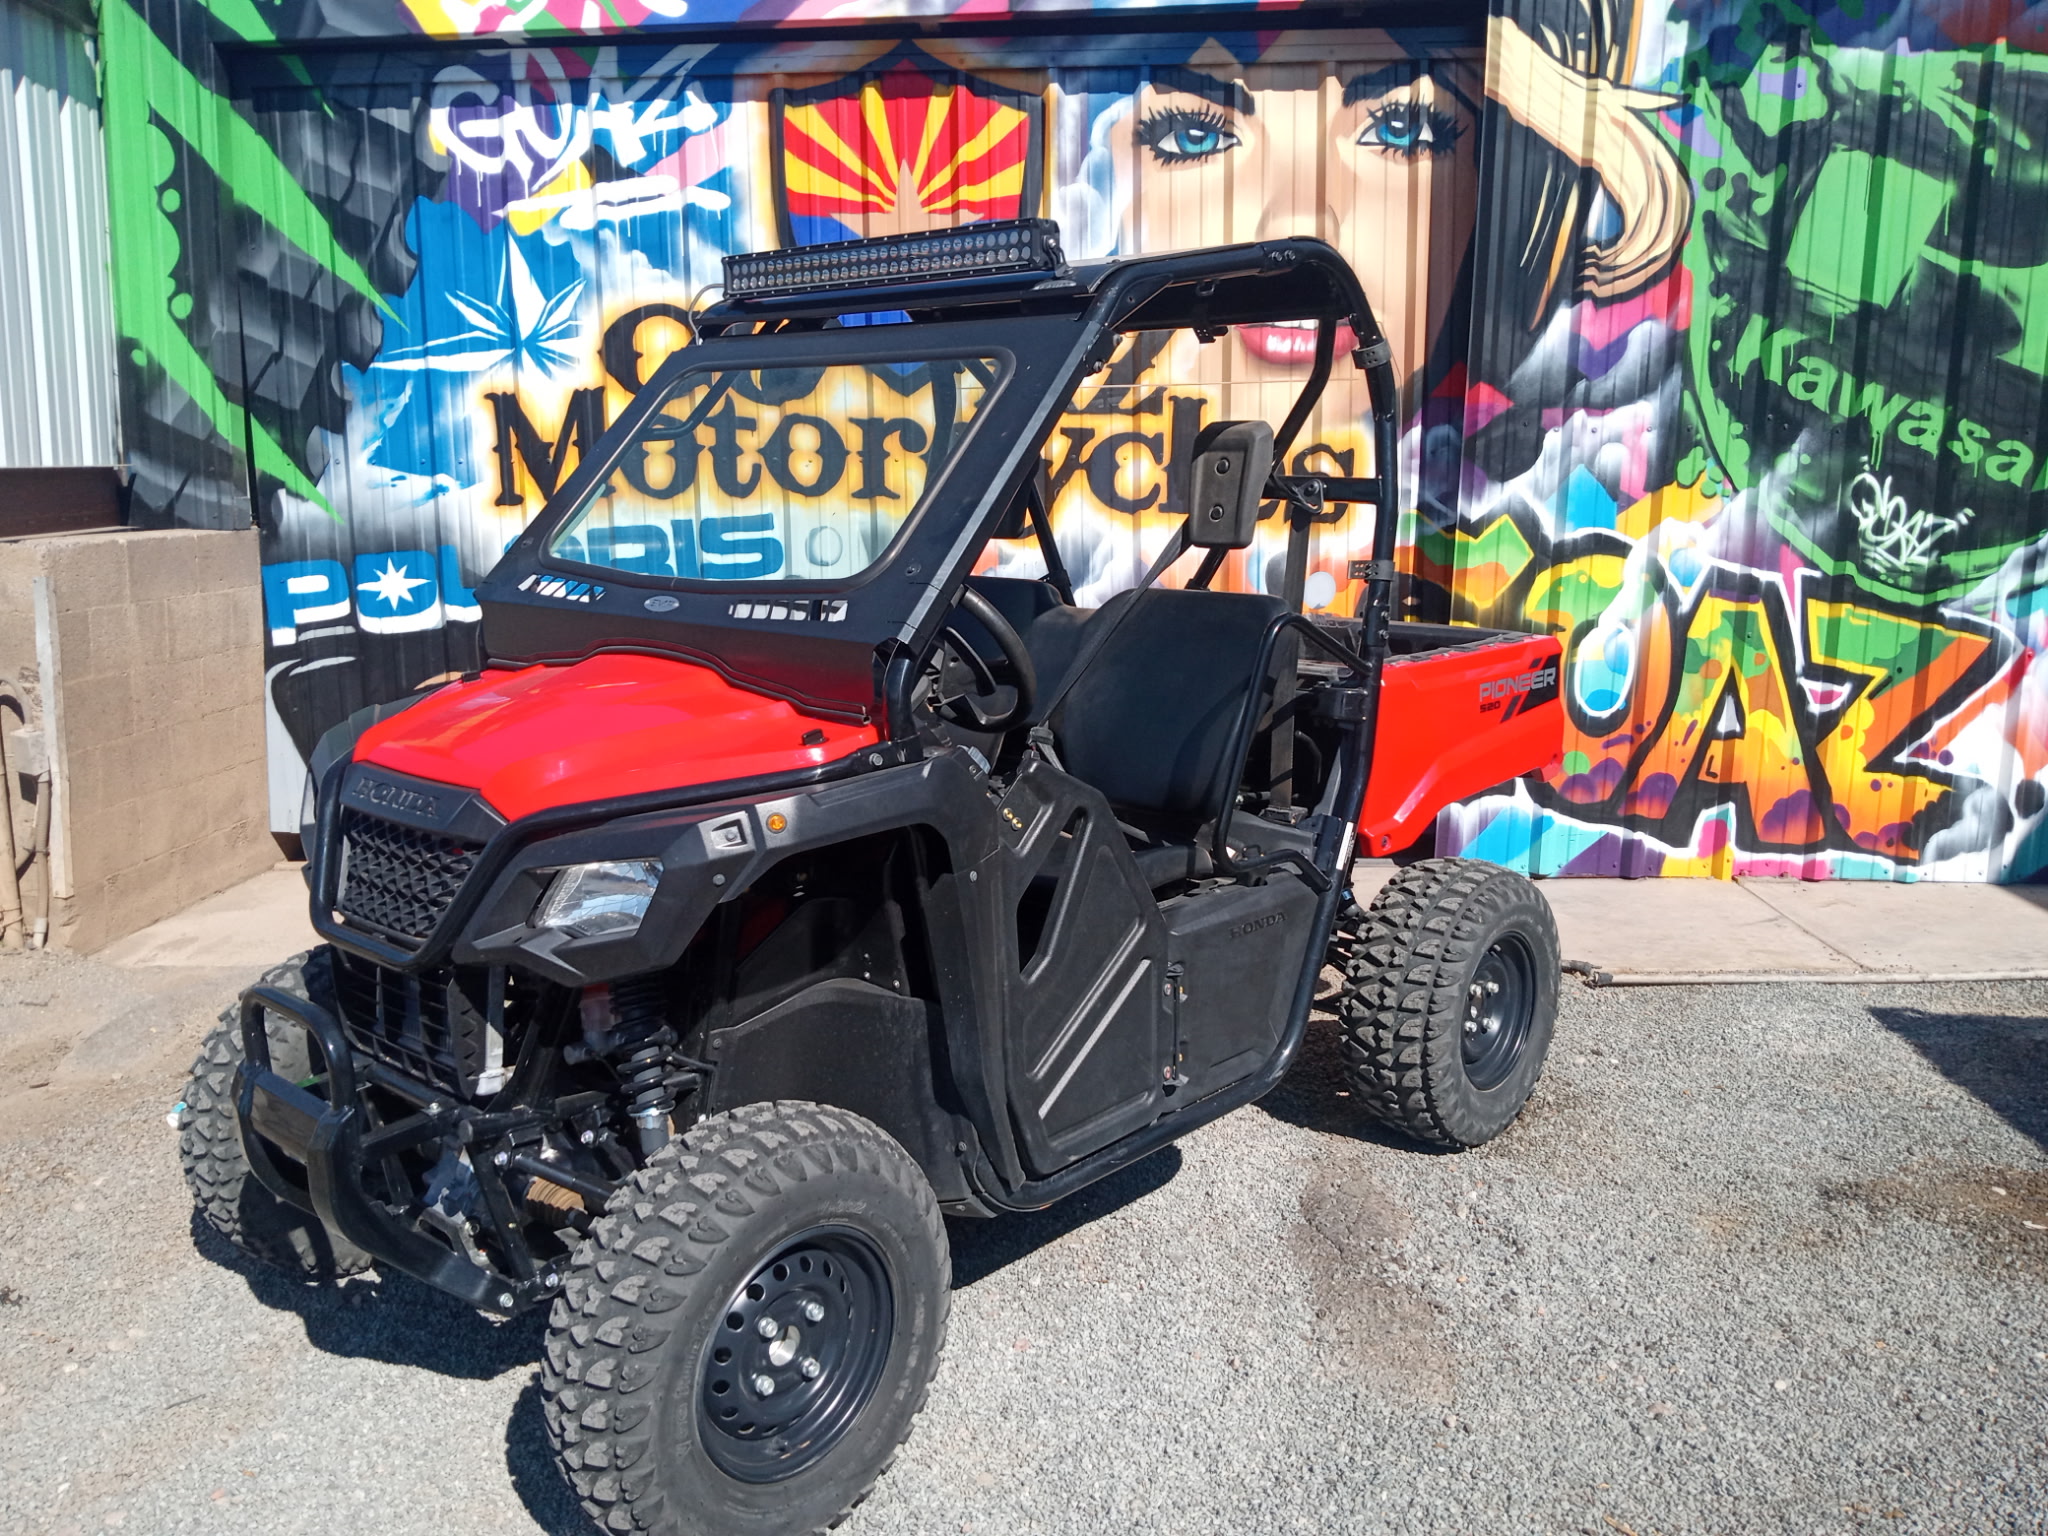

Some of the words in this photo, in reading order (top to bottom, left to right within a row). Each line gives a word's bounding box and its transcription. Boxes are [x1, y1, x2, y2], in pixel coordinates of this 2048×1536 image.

[1728, 313, 2048, 492] Kawasa
[1479, 666, 1557, 702] PIONEER
[1480, 700, 1501, 714] 520
[1229, 911, 1286, 939] HONDA
